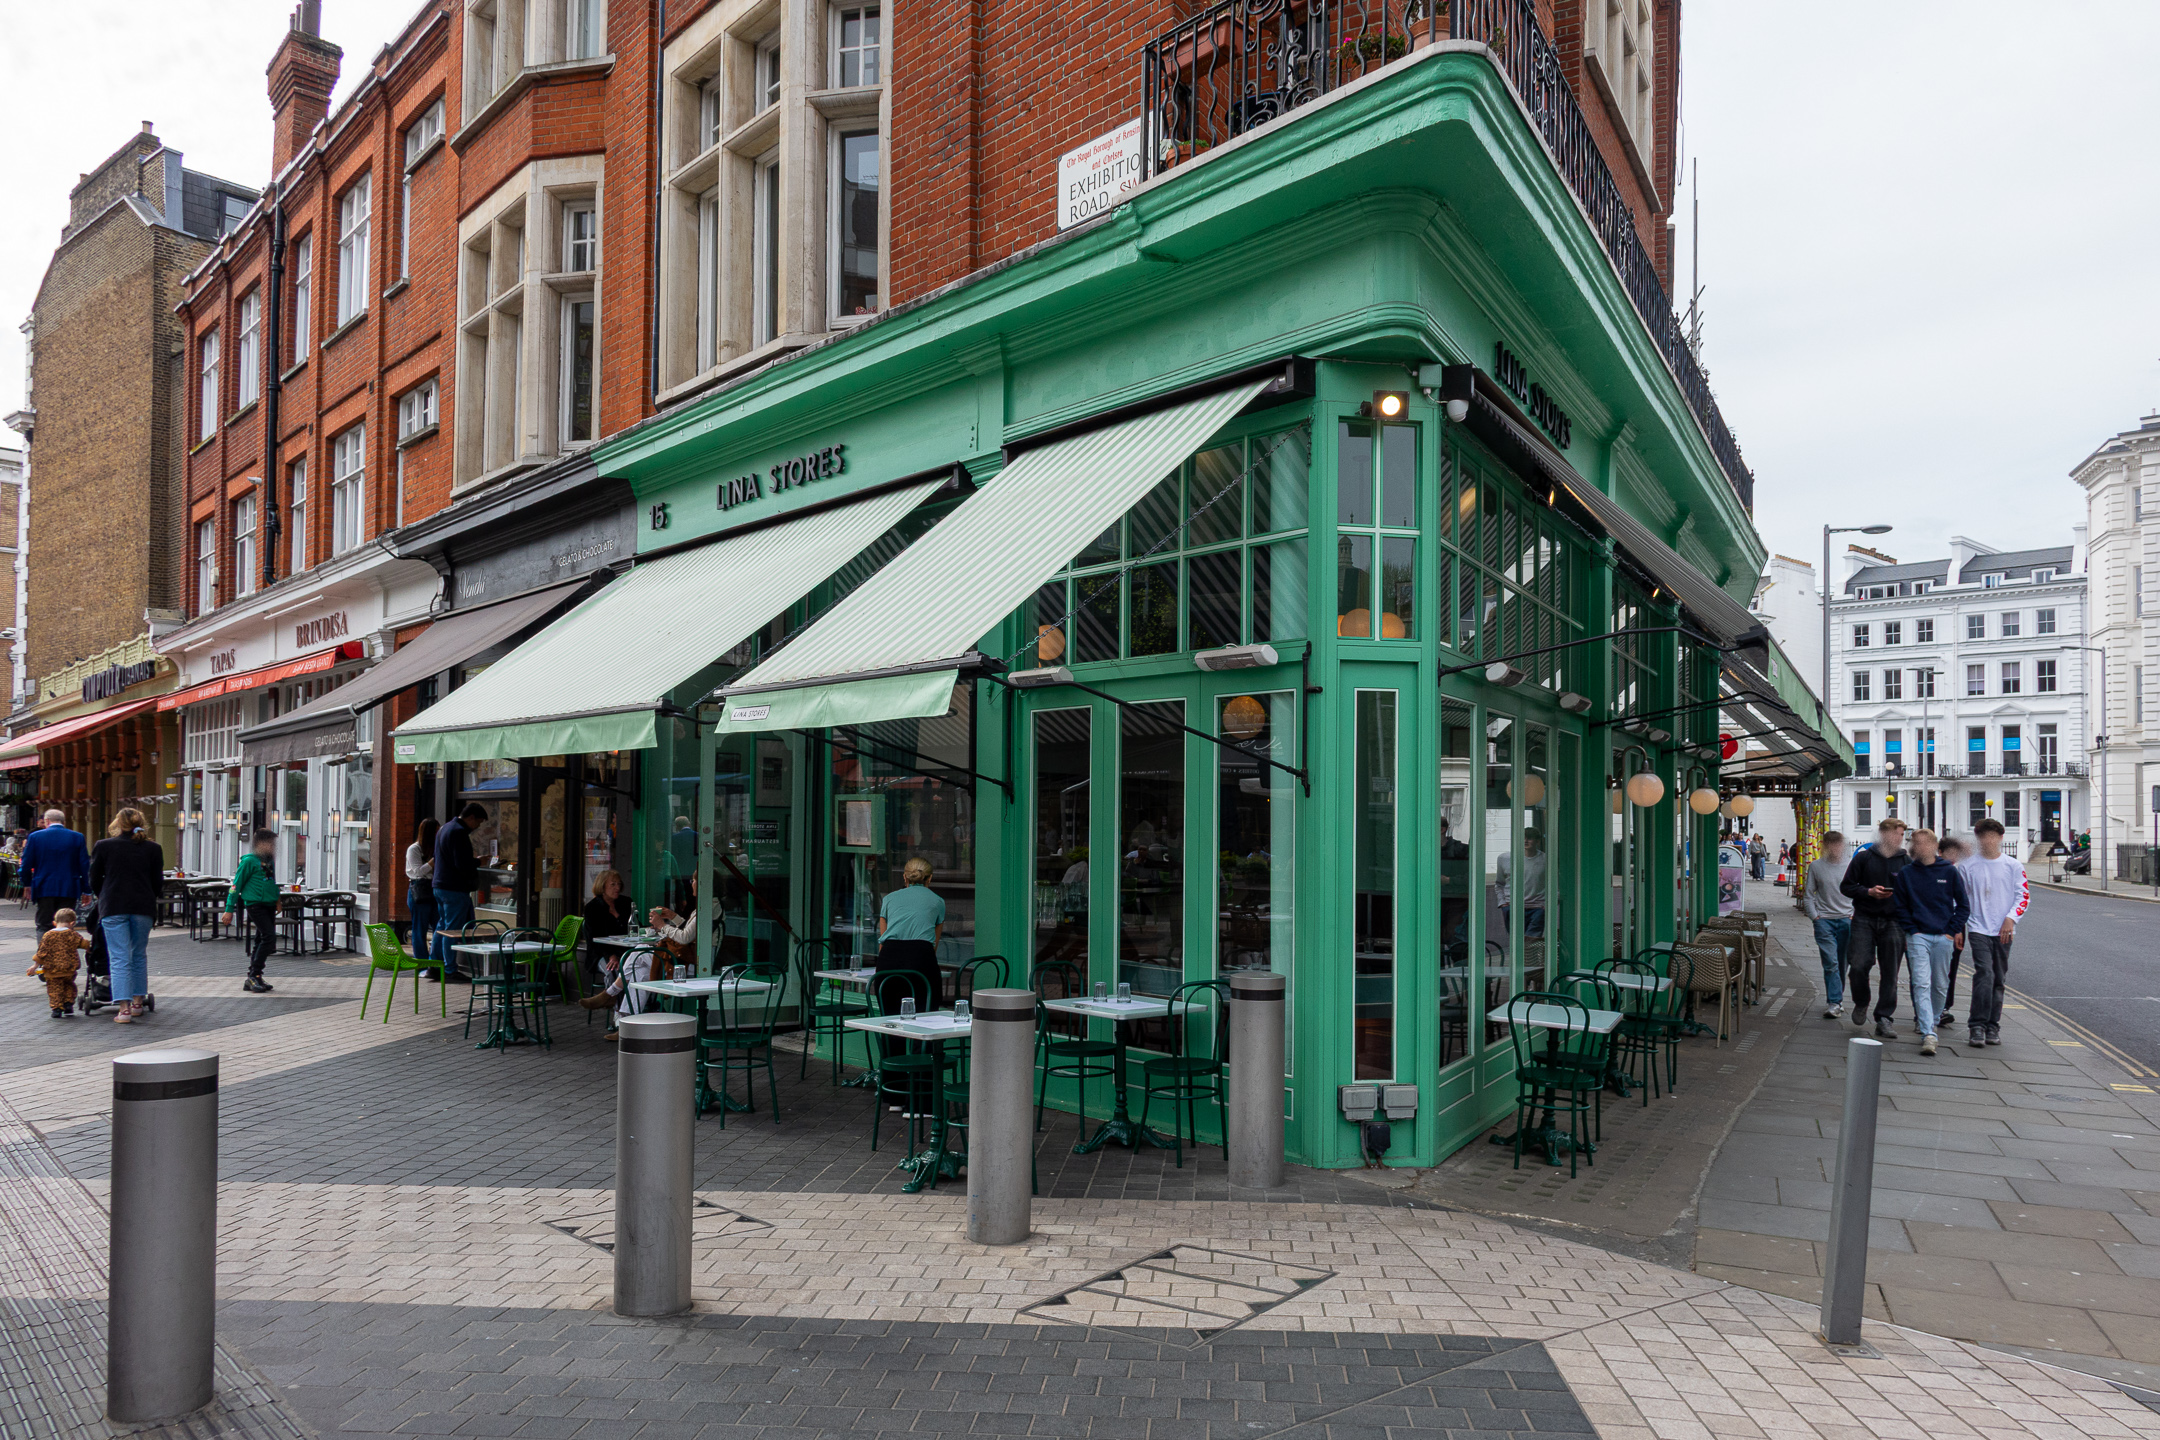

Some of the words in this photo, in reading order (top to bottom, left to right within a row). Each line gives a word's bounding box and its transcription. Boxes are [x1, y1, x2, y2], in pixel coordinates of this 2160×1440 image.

[1066, 157, 1076, 168] The
[1077, 149, 1092, 165] Royal
[1093, 138, 1114, 156] Borough
[1115, 133, 1122, 144] of
[1092, 159, 1101, 170] and
[1103, 149, 1123, 165] Chelsea
[1495, 340, 1529, 405] LINA
[1529, 382, 1572, 450] STORES
[716, 473, 761, 510] LINA
[769, 443, 845, 493] STORES
[649, 502, 668, 530] 15
[559, 552, 578, 567] GELATO
[582, 539, 615, 560] CHOCOLATE
[459, 568, 487, 599] Venchi
[210, 648, 236, 675] TAPAS
[296, 610, 349, 648] BRINDISA
[748, 709, 767, 718] STORES
